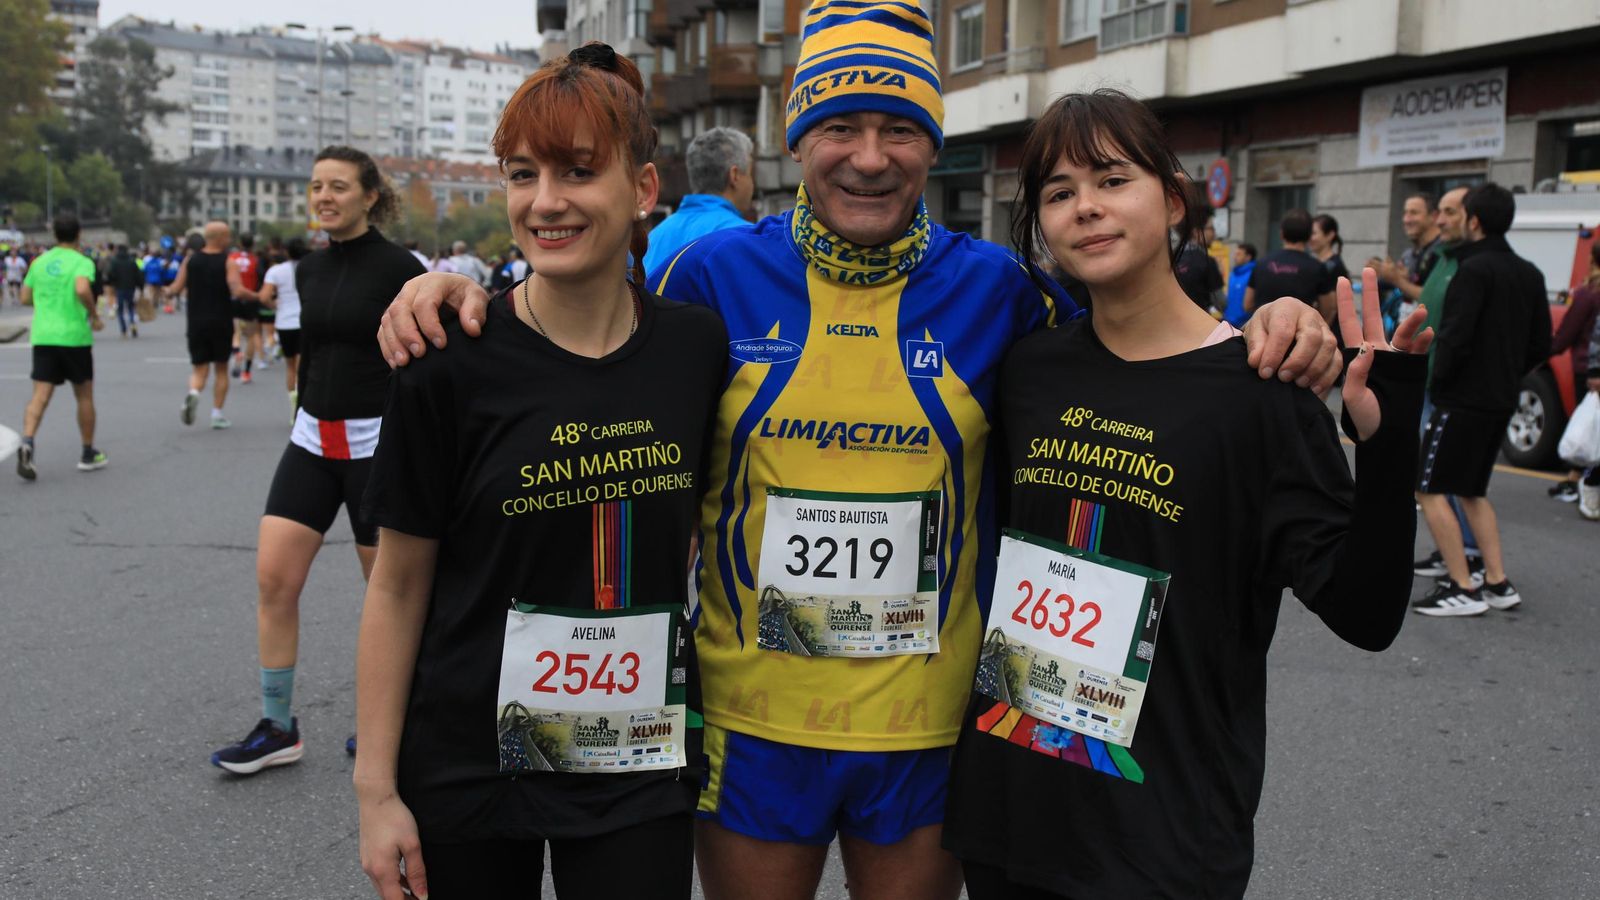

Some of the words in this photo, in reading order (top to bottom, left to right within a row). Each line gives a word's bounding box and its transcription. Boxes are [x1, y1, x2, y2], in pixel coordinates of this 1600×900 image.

[1391, 78, 1504, 118] AODEMPER
[826, 324, 879, 338] KELTIA
[766, 344, 792, 352] Seguros
[913, 349, 938, 369] LA
[591, 420, 654, 440] CARREIRA
[760, 417, 930, 450] LIMIACTIVA
[1091, 418, 1154, 442] CARREIRA
[520, 458, 572, 488] SAN
[580, 441, 682, 478] MARTIÑO
[1028, 438, 1066, 459] SAN
[1068, 441, 1174, 486] MARTIÑO
[502, 486, 599, 516] CONCELLO
[604, 482, 628, 500] DE
[632, 472, 692, 495] OURENSE
[1014, 467, 1078, 488] CONCELLO
[1080, 475, 1102, 494] DE
[1104, 480, 1184, 522] OURENSE
[796, 508, 836, 524] SANTOS
[840, 510, 888, 524] BAUTISTA
[785, 534, 894, 580] 3219
[1048, 560, 1076, 582] MARÍA
[886, 609, 924, 625] XLVIII
[1011, 579, 1102, 648] 2632
[571, 626, 616, 640] AVELINA
[532, 650, 641, 696] 2543
[1032, 664, 1048, 674] SAN
[1028, 680, 1064, 697] OURENSE
[1077, 682, 1126, 710] XLVIII
[630, 722, 671, 739] XLVIII
